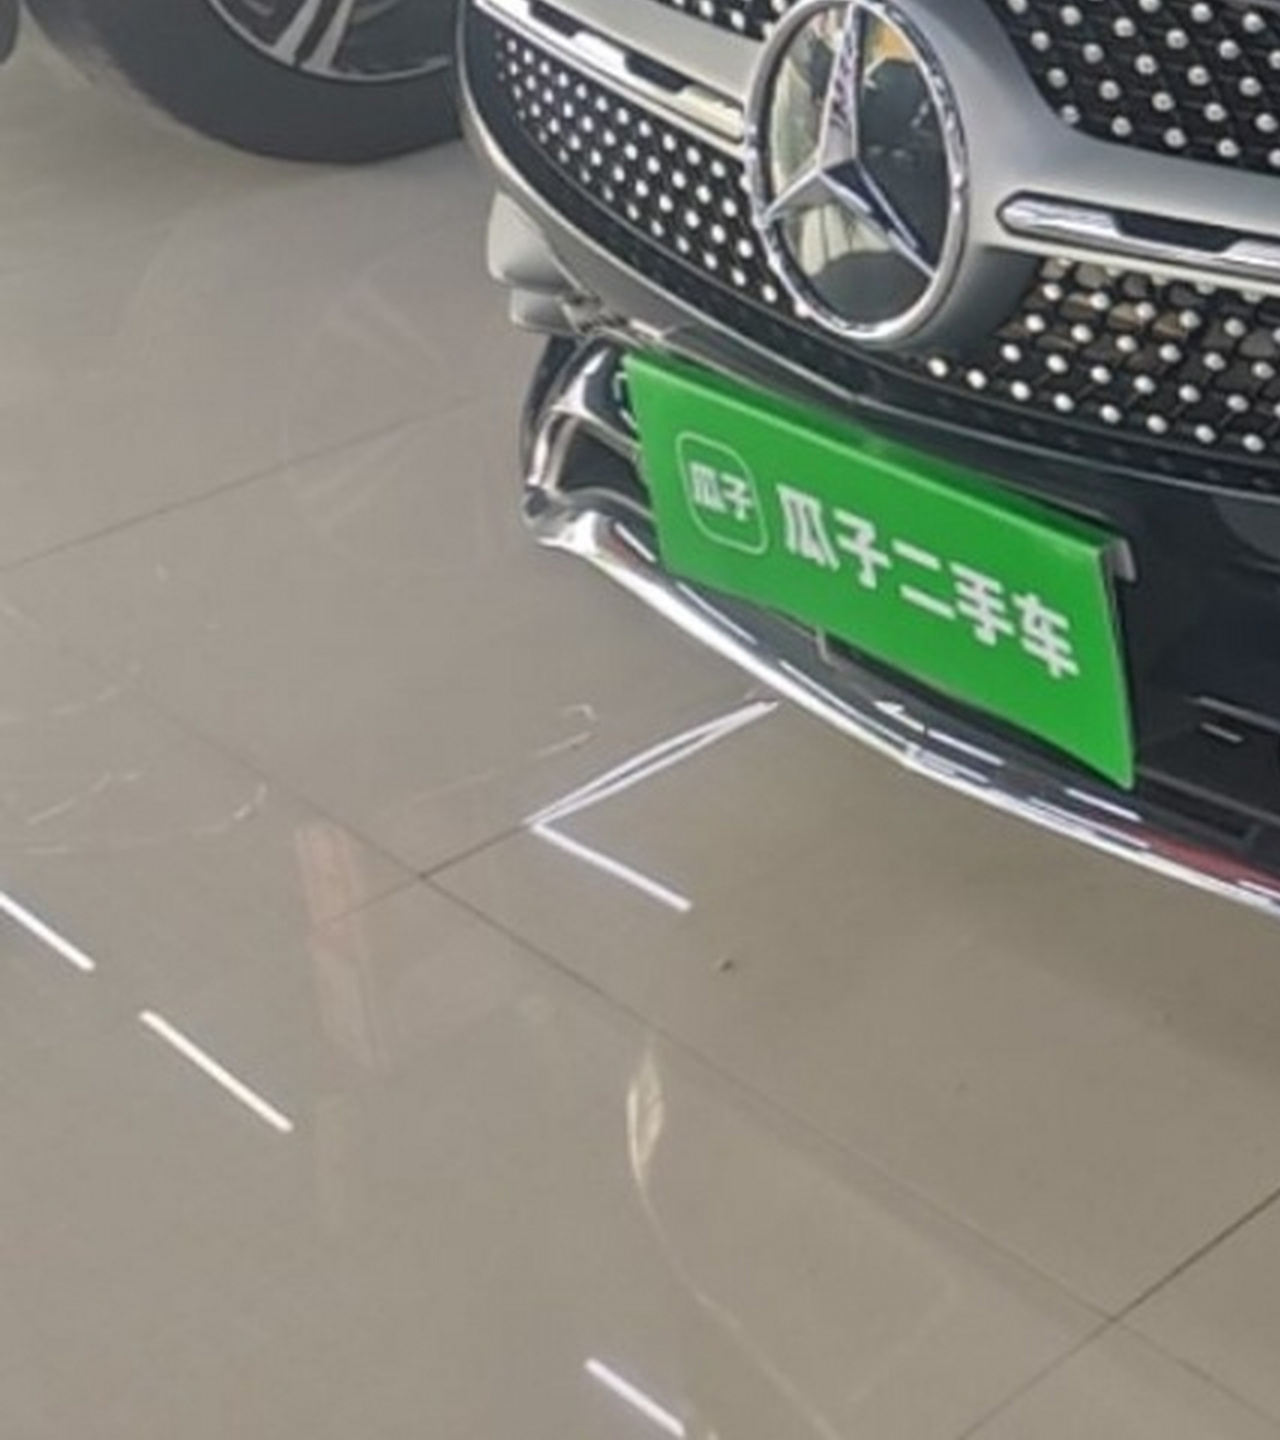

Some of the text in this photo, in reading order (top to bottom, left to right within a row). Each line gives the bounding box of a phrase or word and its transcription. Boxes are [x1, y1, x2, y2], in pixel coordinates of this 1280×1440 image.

[690, 462, 752, 521] 瓜子
[776, 482, 1080, 679] 瓜子二手车
